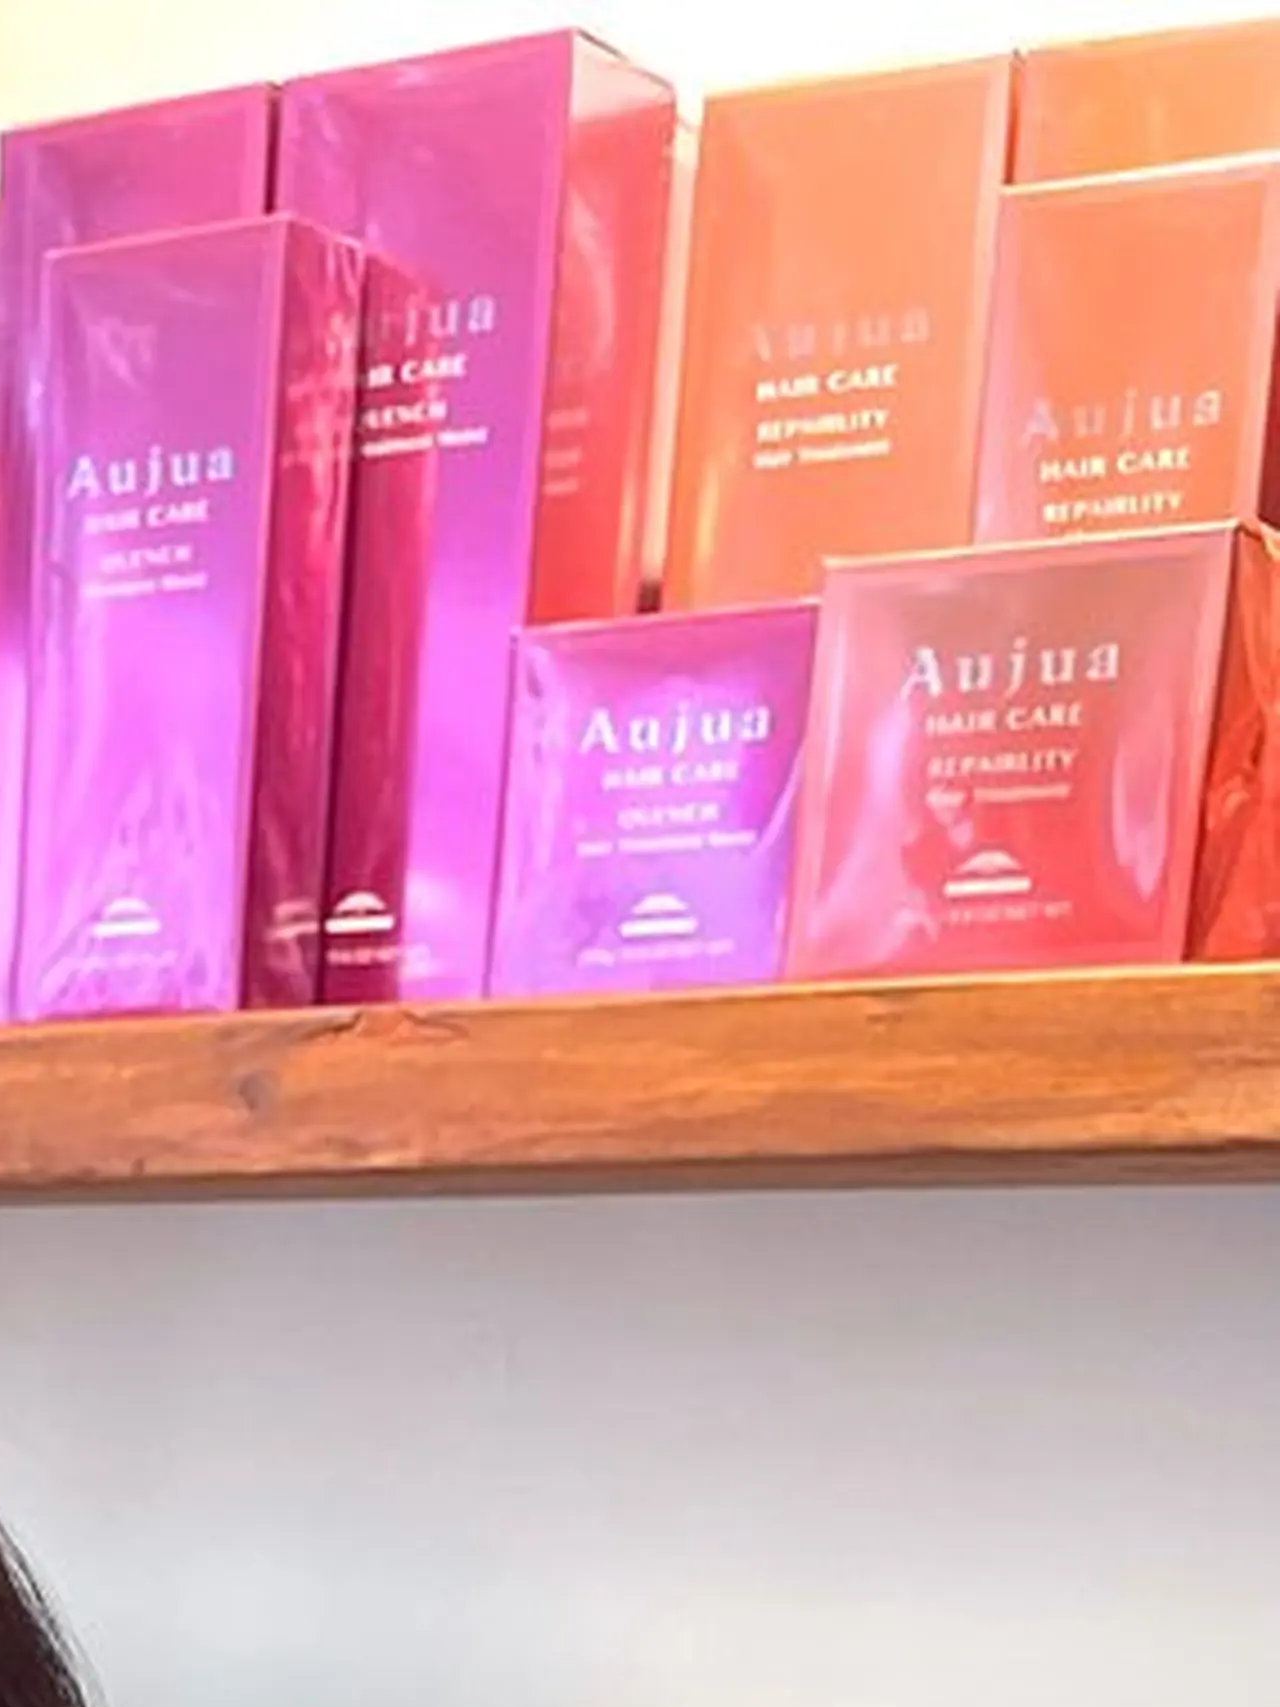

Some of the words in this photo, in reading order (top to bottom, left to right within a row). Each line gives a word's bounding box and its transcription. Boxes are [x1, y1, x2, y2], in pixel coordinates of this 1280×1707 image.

[826, 363, 899, 395] CARE
[1020, 387, 1222, 445] Aujua
[66, 443, 235, 500] Aujua
[1039, 455, 1107, 483] HAIR
[1115, 445, 1190, 476] CARE
[145, 498, 209, 530] CARE
[899, 635, 1120, 698] Aujua
[578, 702, 772, 755] Aujua
[925, 708, 998, 736] HAIR
[1004, 702, 1083, 731] CARE
